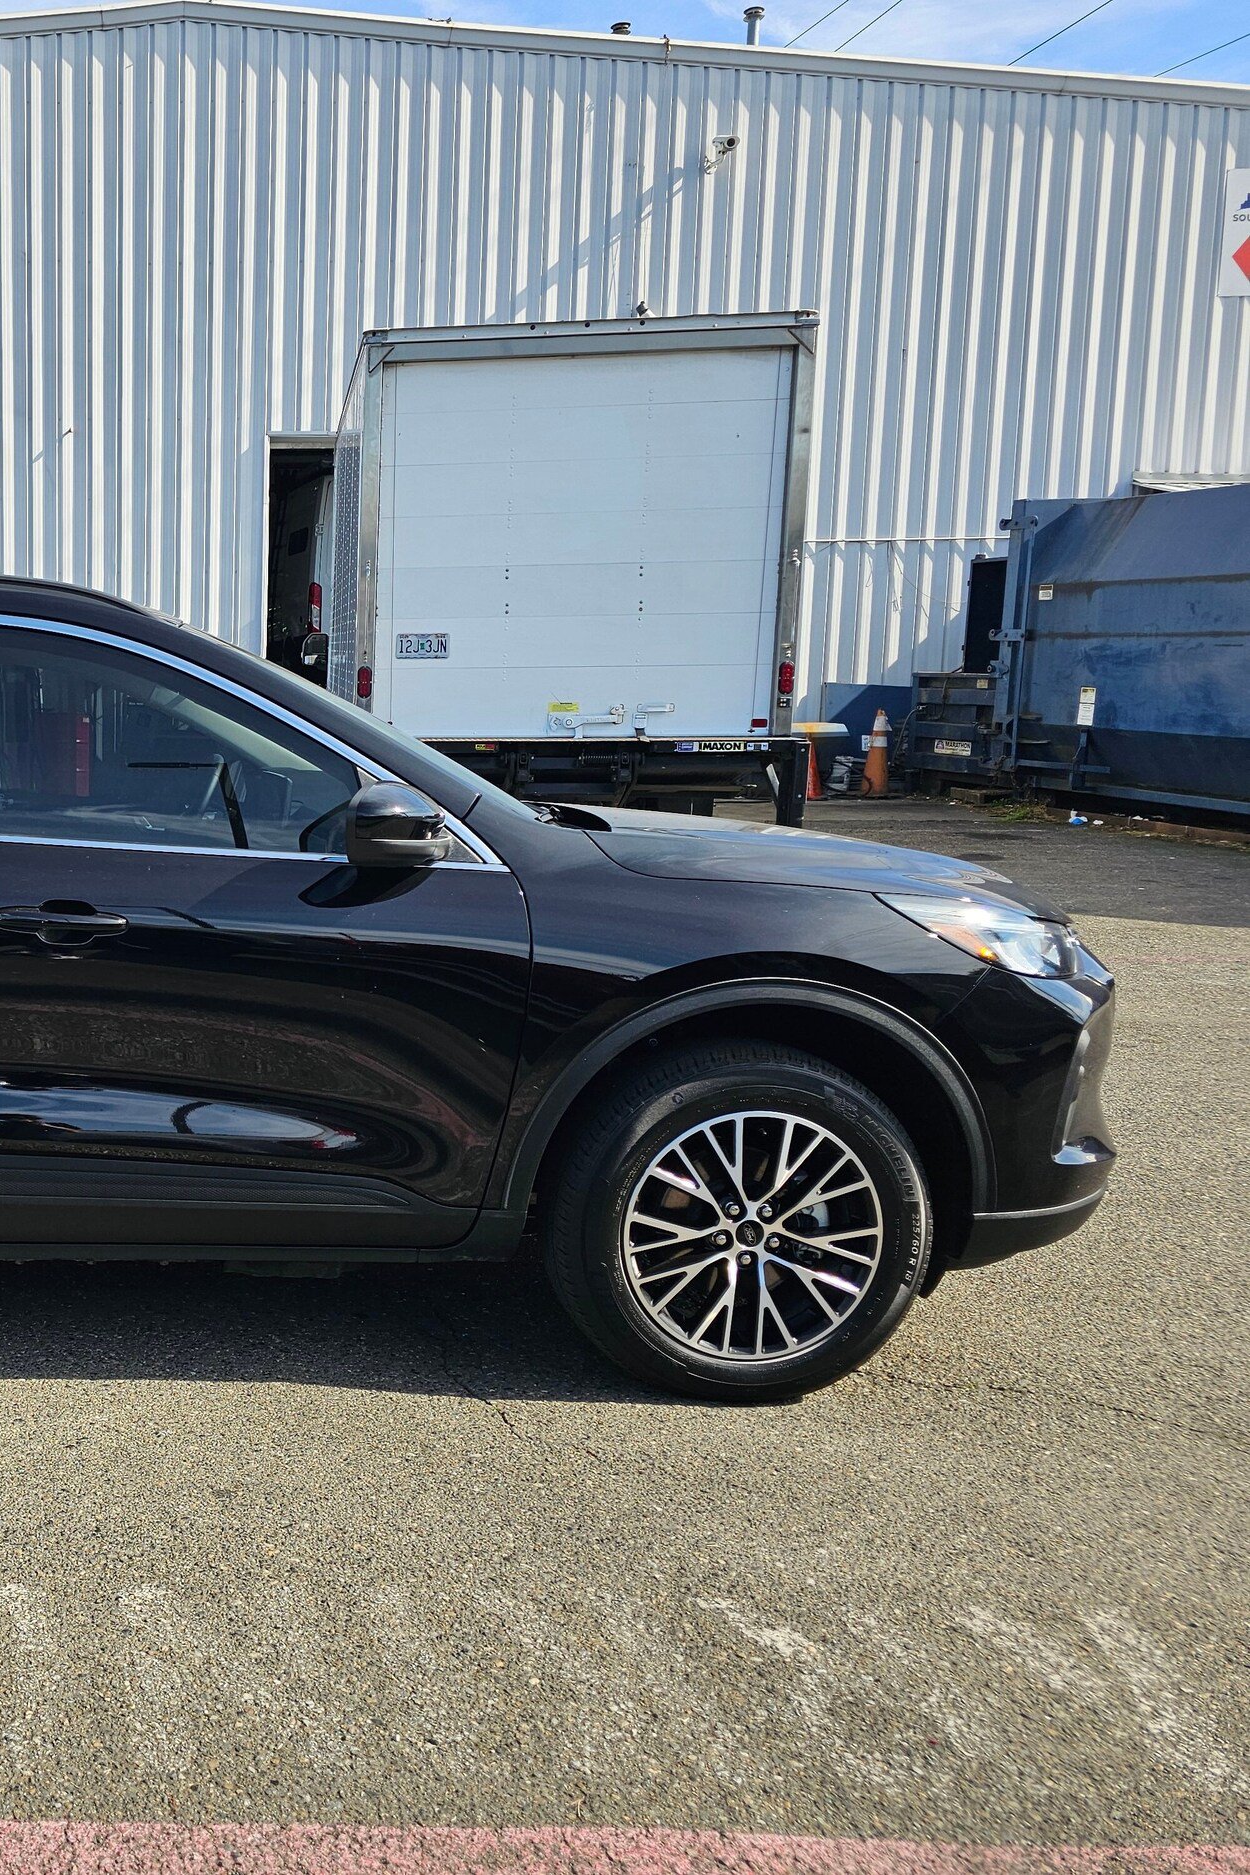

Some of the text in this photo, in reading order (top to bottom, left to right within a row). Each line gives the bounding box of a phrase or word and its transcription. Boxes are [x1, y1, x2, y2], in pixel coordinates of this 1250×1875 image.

[702, 742, 742, 751] MAXON
[861, 1114, 915, 1197] MICHELIN
[904, 1213, 920, 1282] 225/60 R 18
